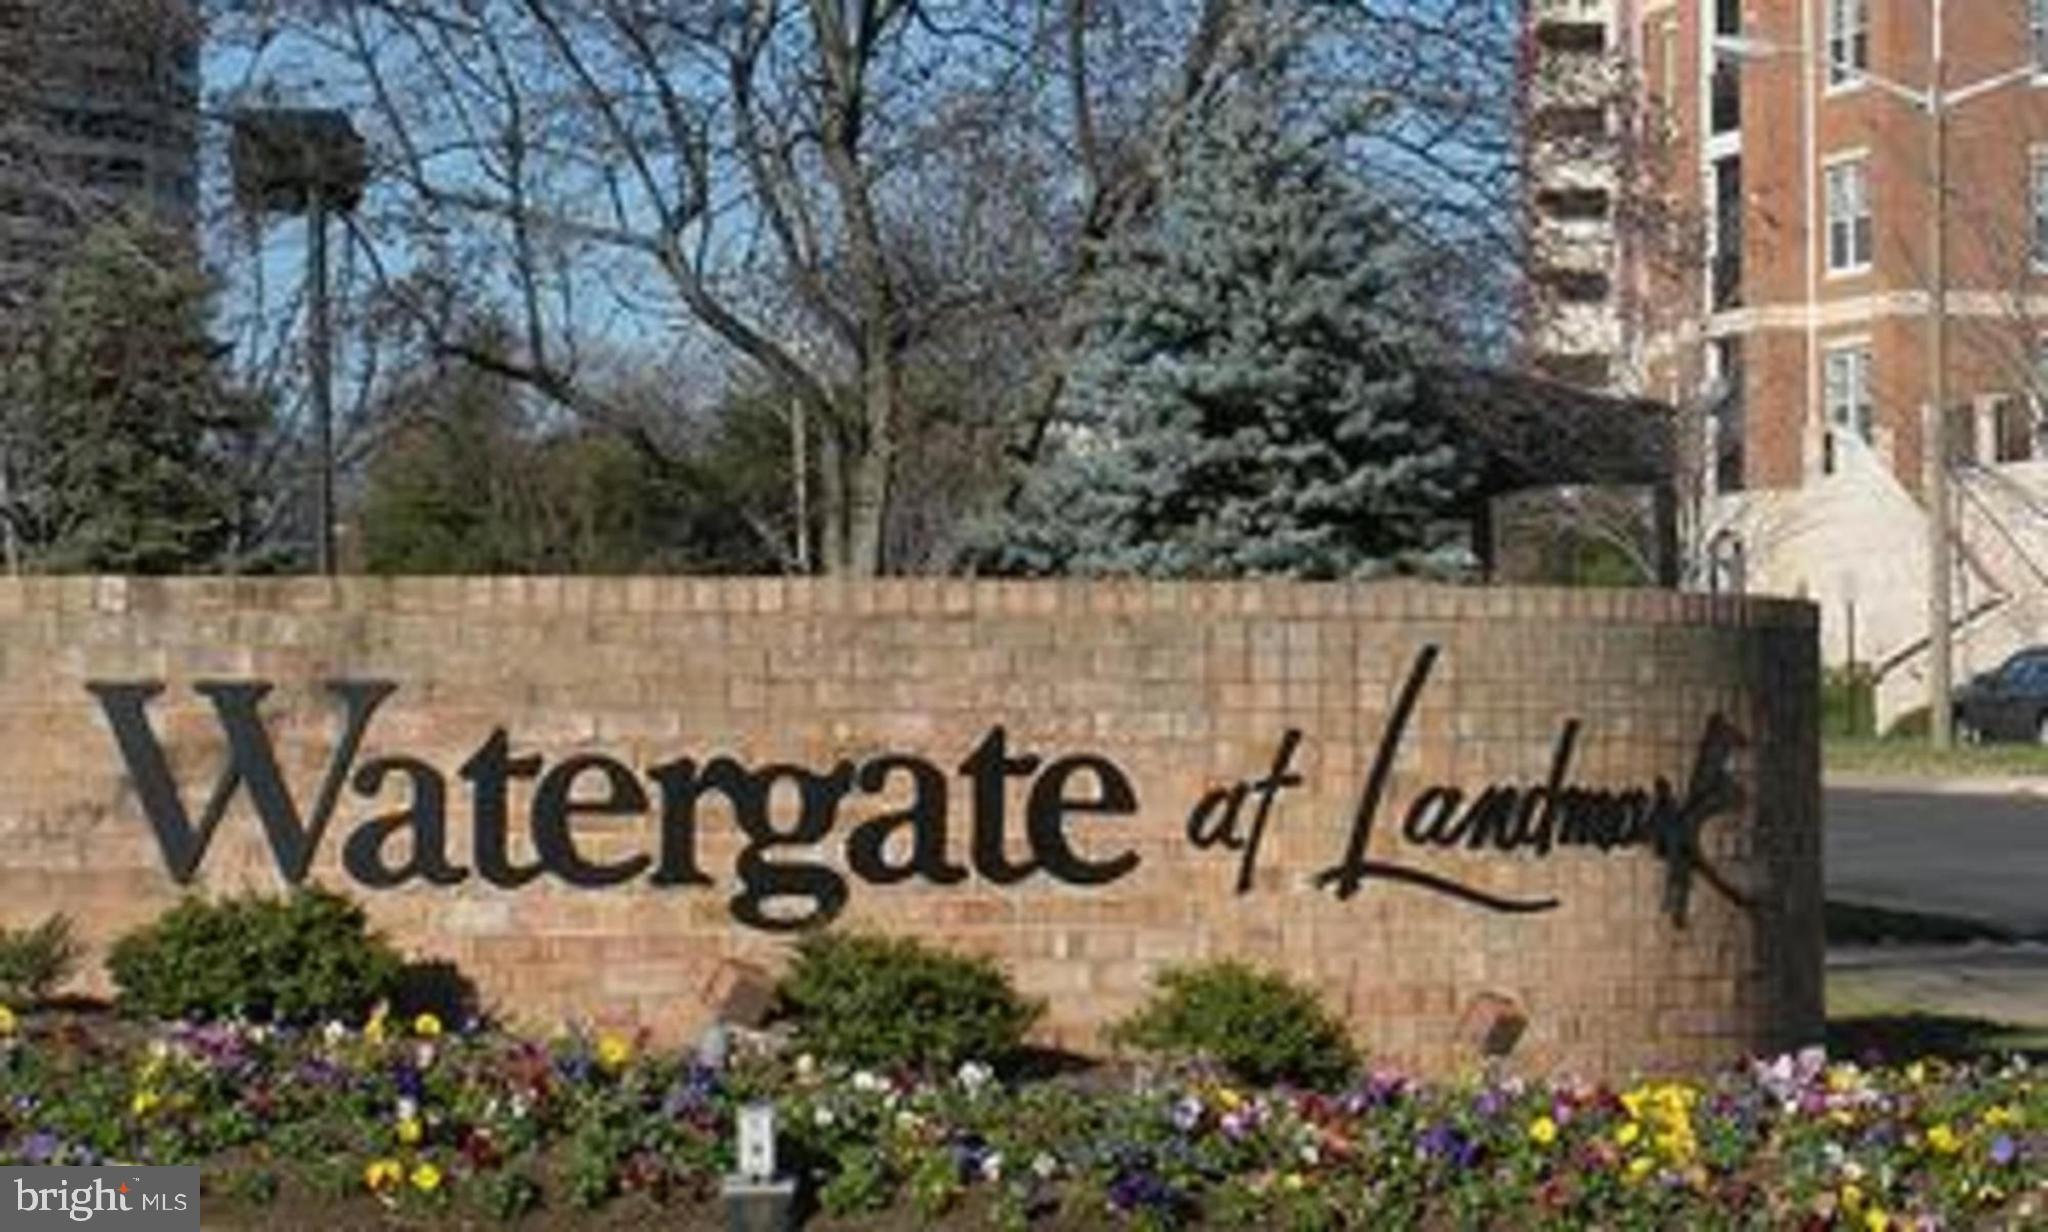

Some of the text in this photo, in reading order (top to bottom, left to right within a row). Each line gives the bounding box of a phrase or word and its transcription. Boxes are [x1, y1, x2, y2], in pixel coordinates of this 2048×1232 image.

[86, 644, 1757, 931] Watergate at Landmark
